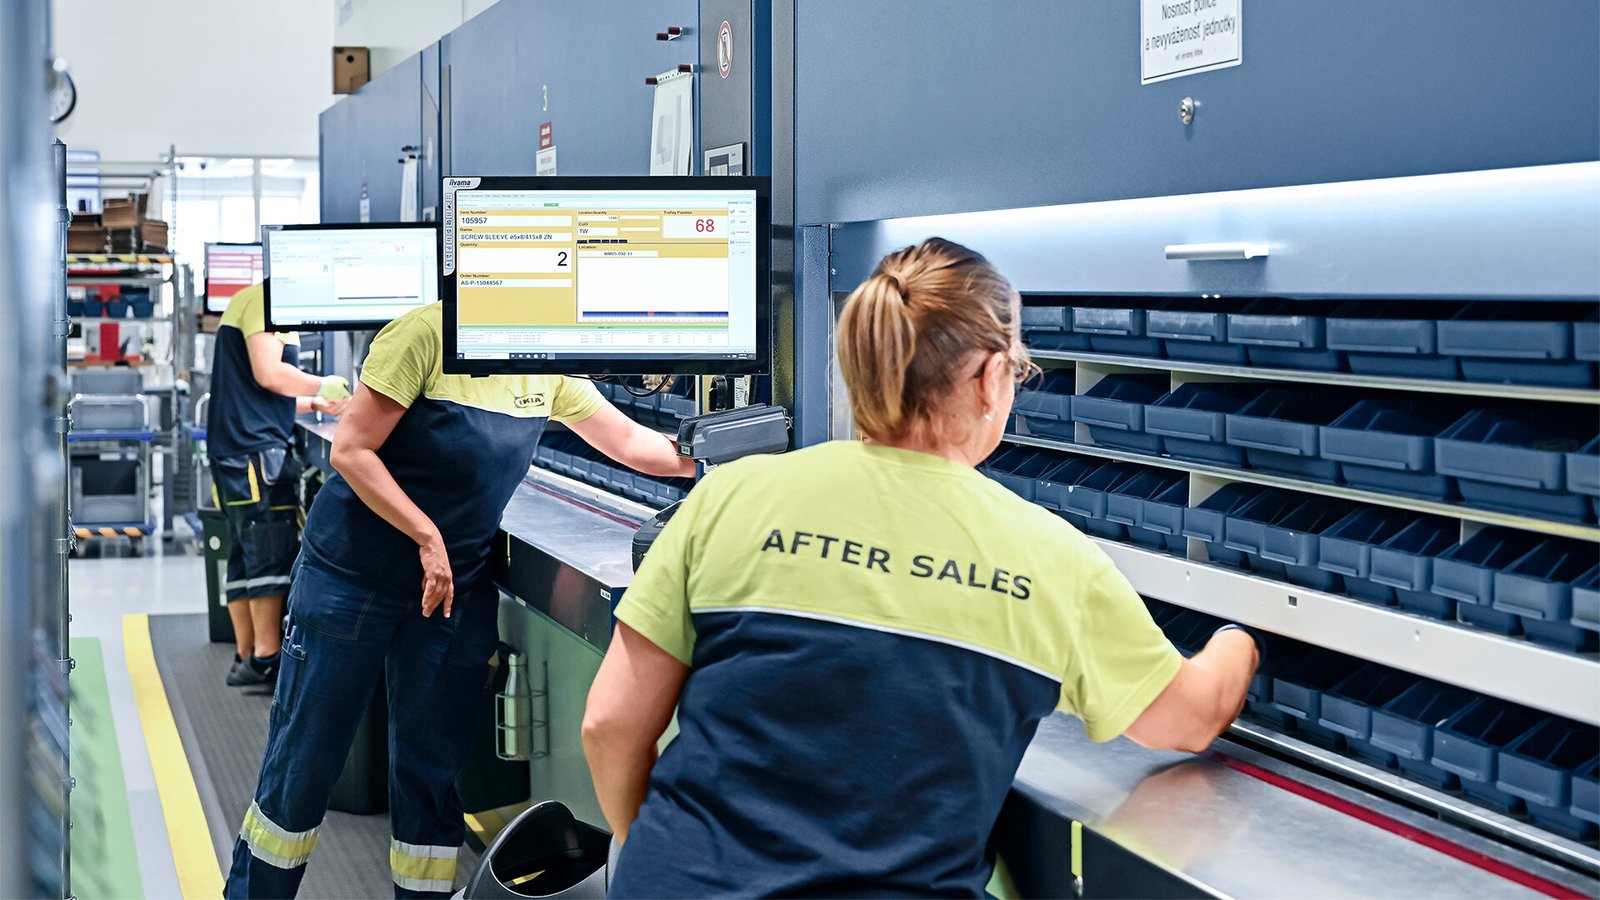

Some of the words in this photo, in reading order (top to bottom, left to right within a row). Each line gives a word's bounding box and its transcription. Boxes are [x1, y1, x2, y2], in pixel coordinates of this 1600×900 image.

[1145, 38, 1150, 51] a
[1203, 15, 1236, 41] jednotky
[542, 84, 548, 112] 3
[461, 217, 488, 225] 105957
[695, 219, 715, 233] 68
[557, 251, 568, 267] 2
[761, 529, 891, 573] AFTER
[910, 555, 1032, 600] SALES
